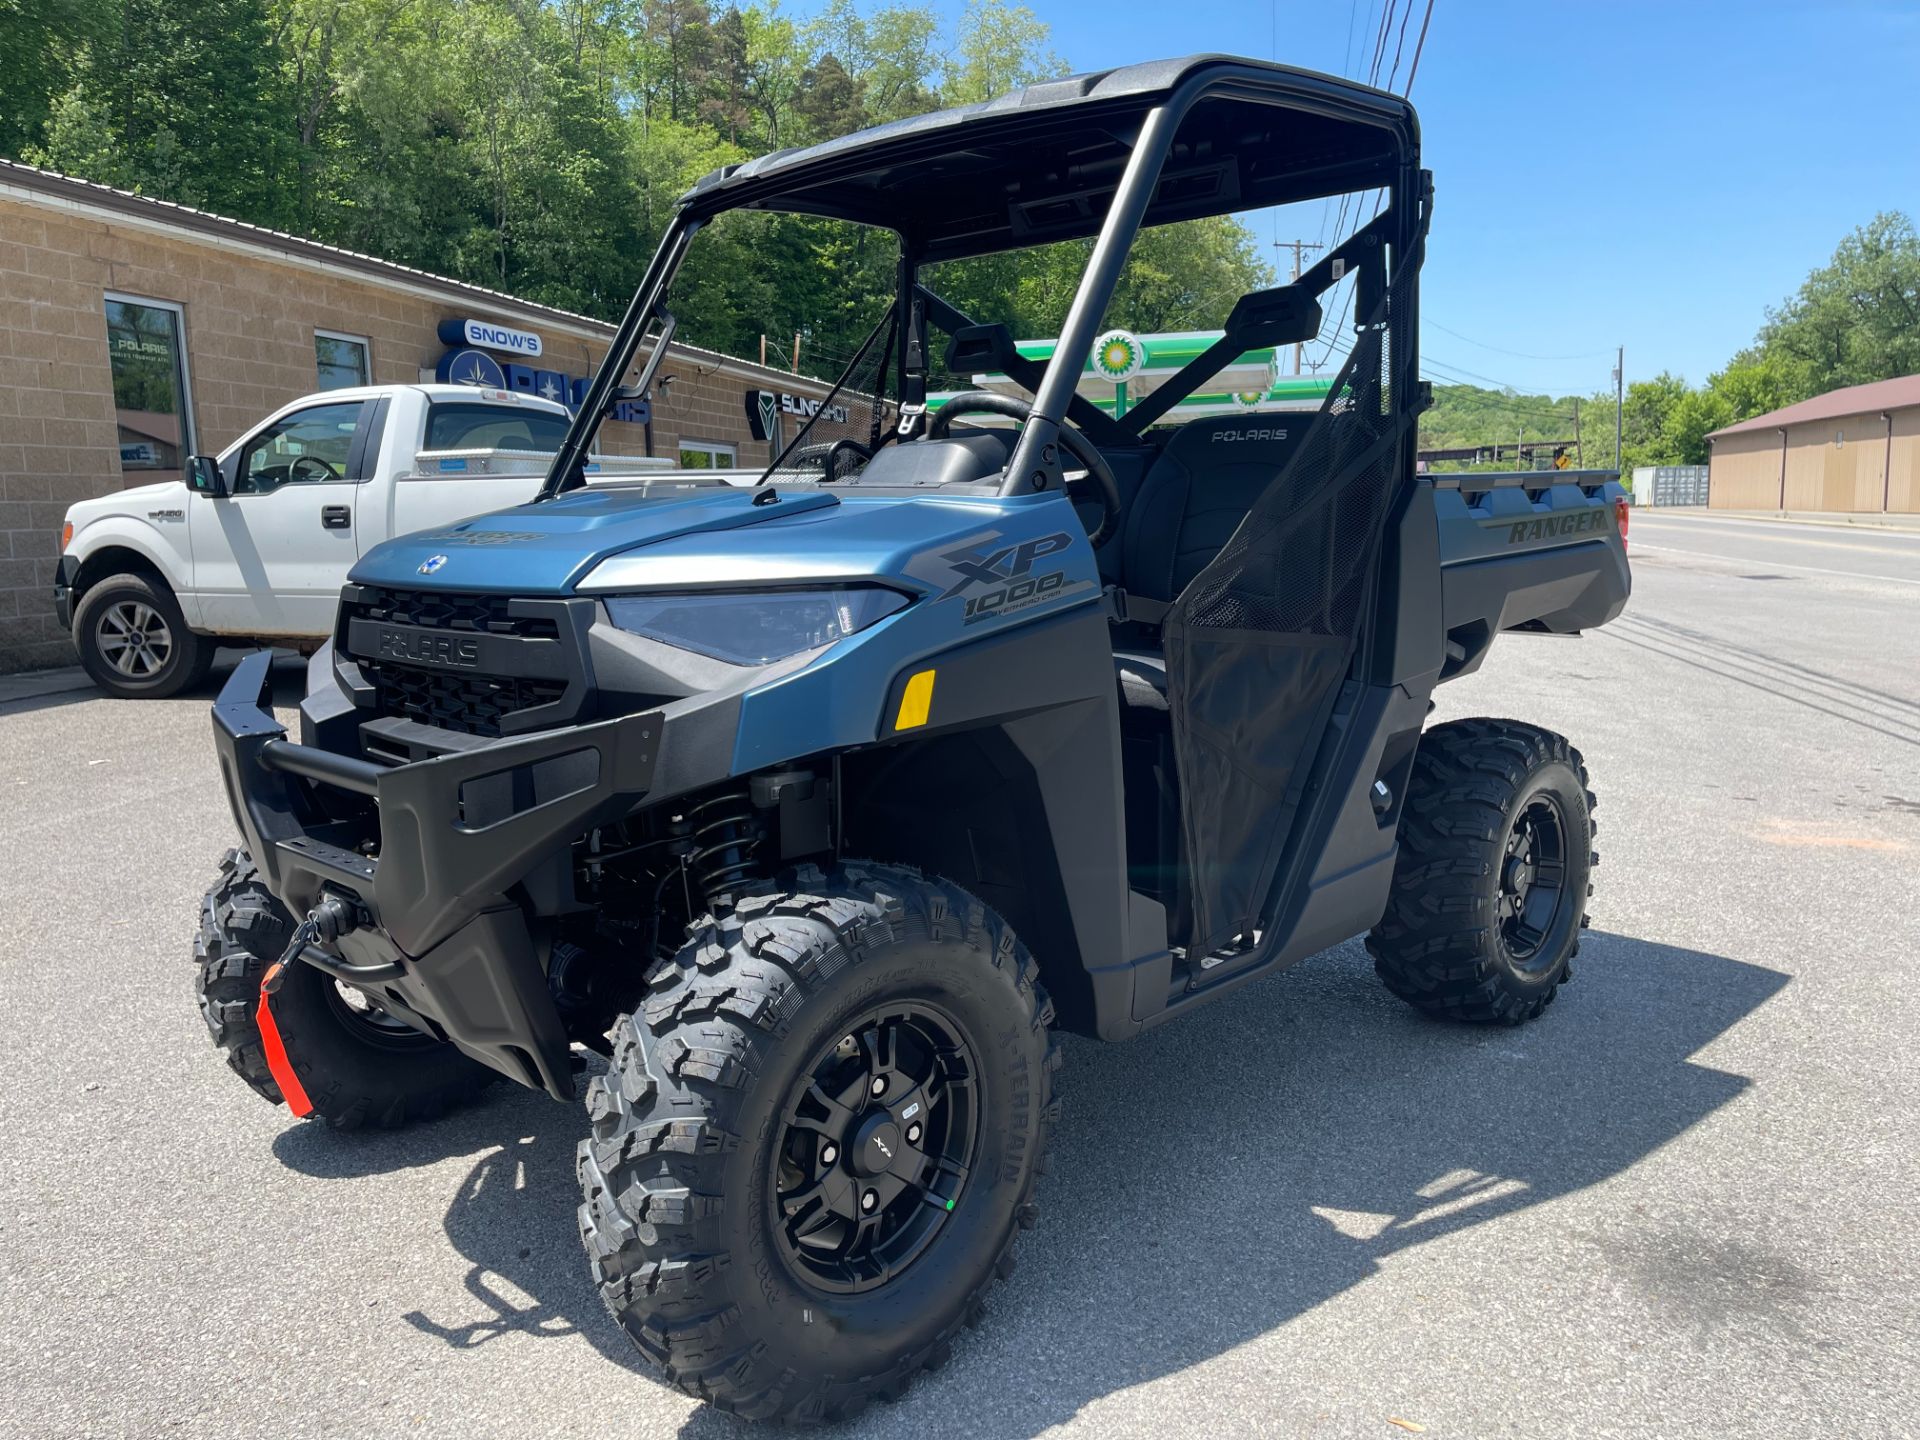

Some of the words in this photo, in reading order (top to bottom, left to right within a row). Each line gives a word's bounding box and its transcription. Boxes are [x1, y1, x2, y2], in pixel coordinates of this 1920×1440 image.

[119, 339, 169, 355] POLARIS
[470, 326, 539, 351] SNOW'S
[503, 363, 651, 425] POLIS
[1211, 429, 1288, 443] POLARIS
[1508, 509, 1609, 545] RANGER
[935, 532, 1074, 603] XP
[964, 570, 1065, 618] 1000
[381, 628, 479, 667] POLARIS
[873, 1136, 892, 1158] XP
